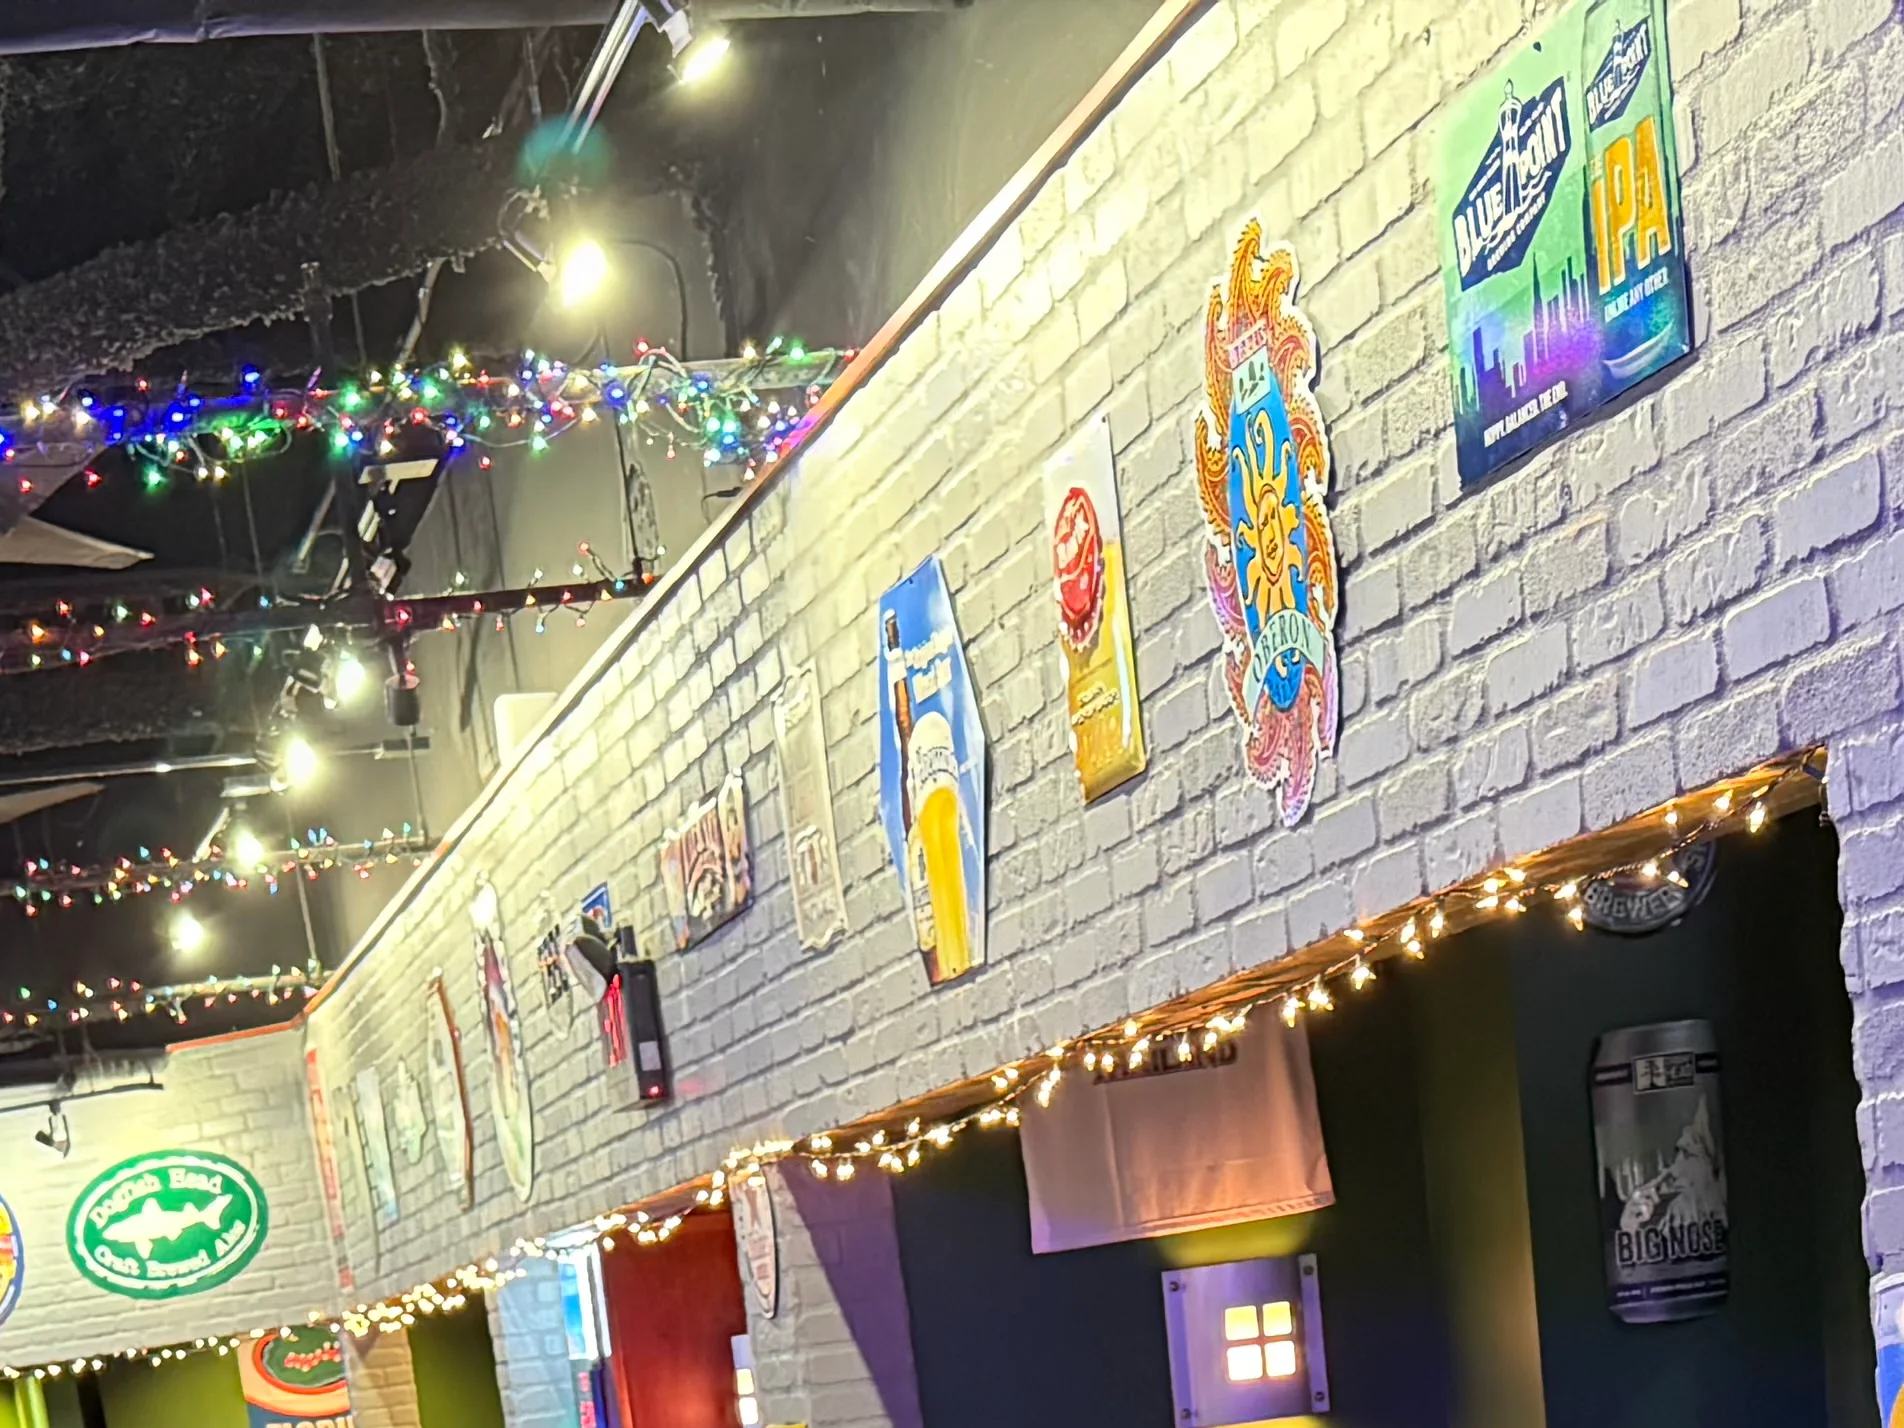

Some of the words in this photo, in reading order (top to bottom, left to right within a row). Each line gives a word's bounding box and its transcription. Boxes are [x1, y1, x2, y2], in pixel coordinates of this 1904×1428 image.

[1519, 86, 1567, 186] POINT
[1454, 181, 1503, 278] BLUE
[1592, 115, 1672, 296] IPA
[1251, 613, 1312, 683] OBERON
[1616, 1224, 1665, 1266] BIG
